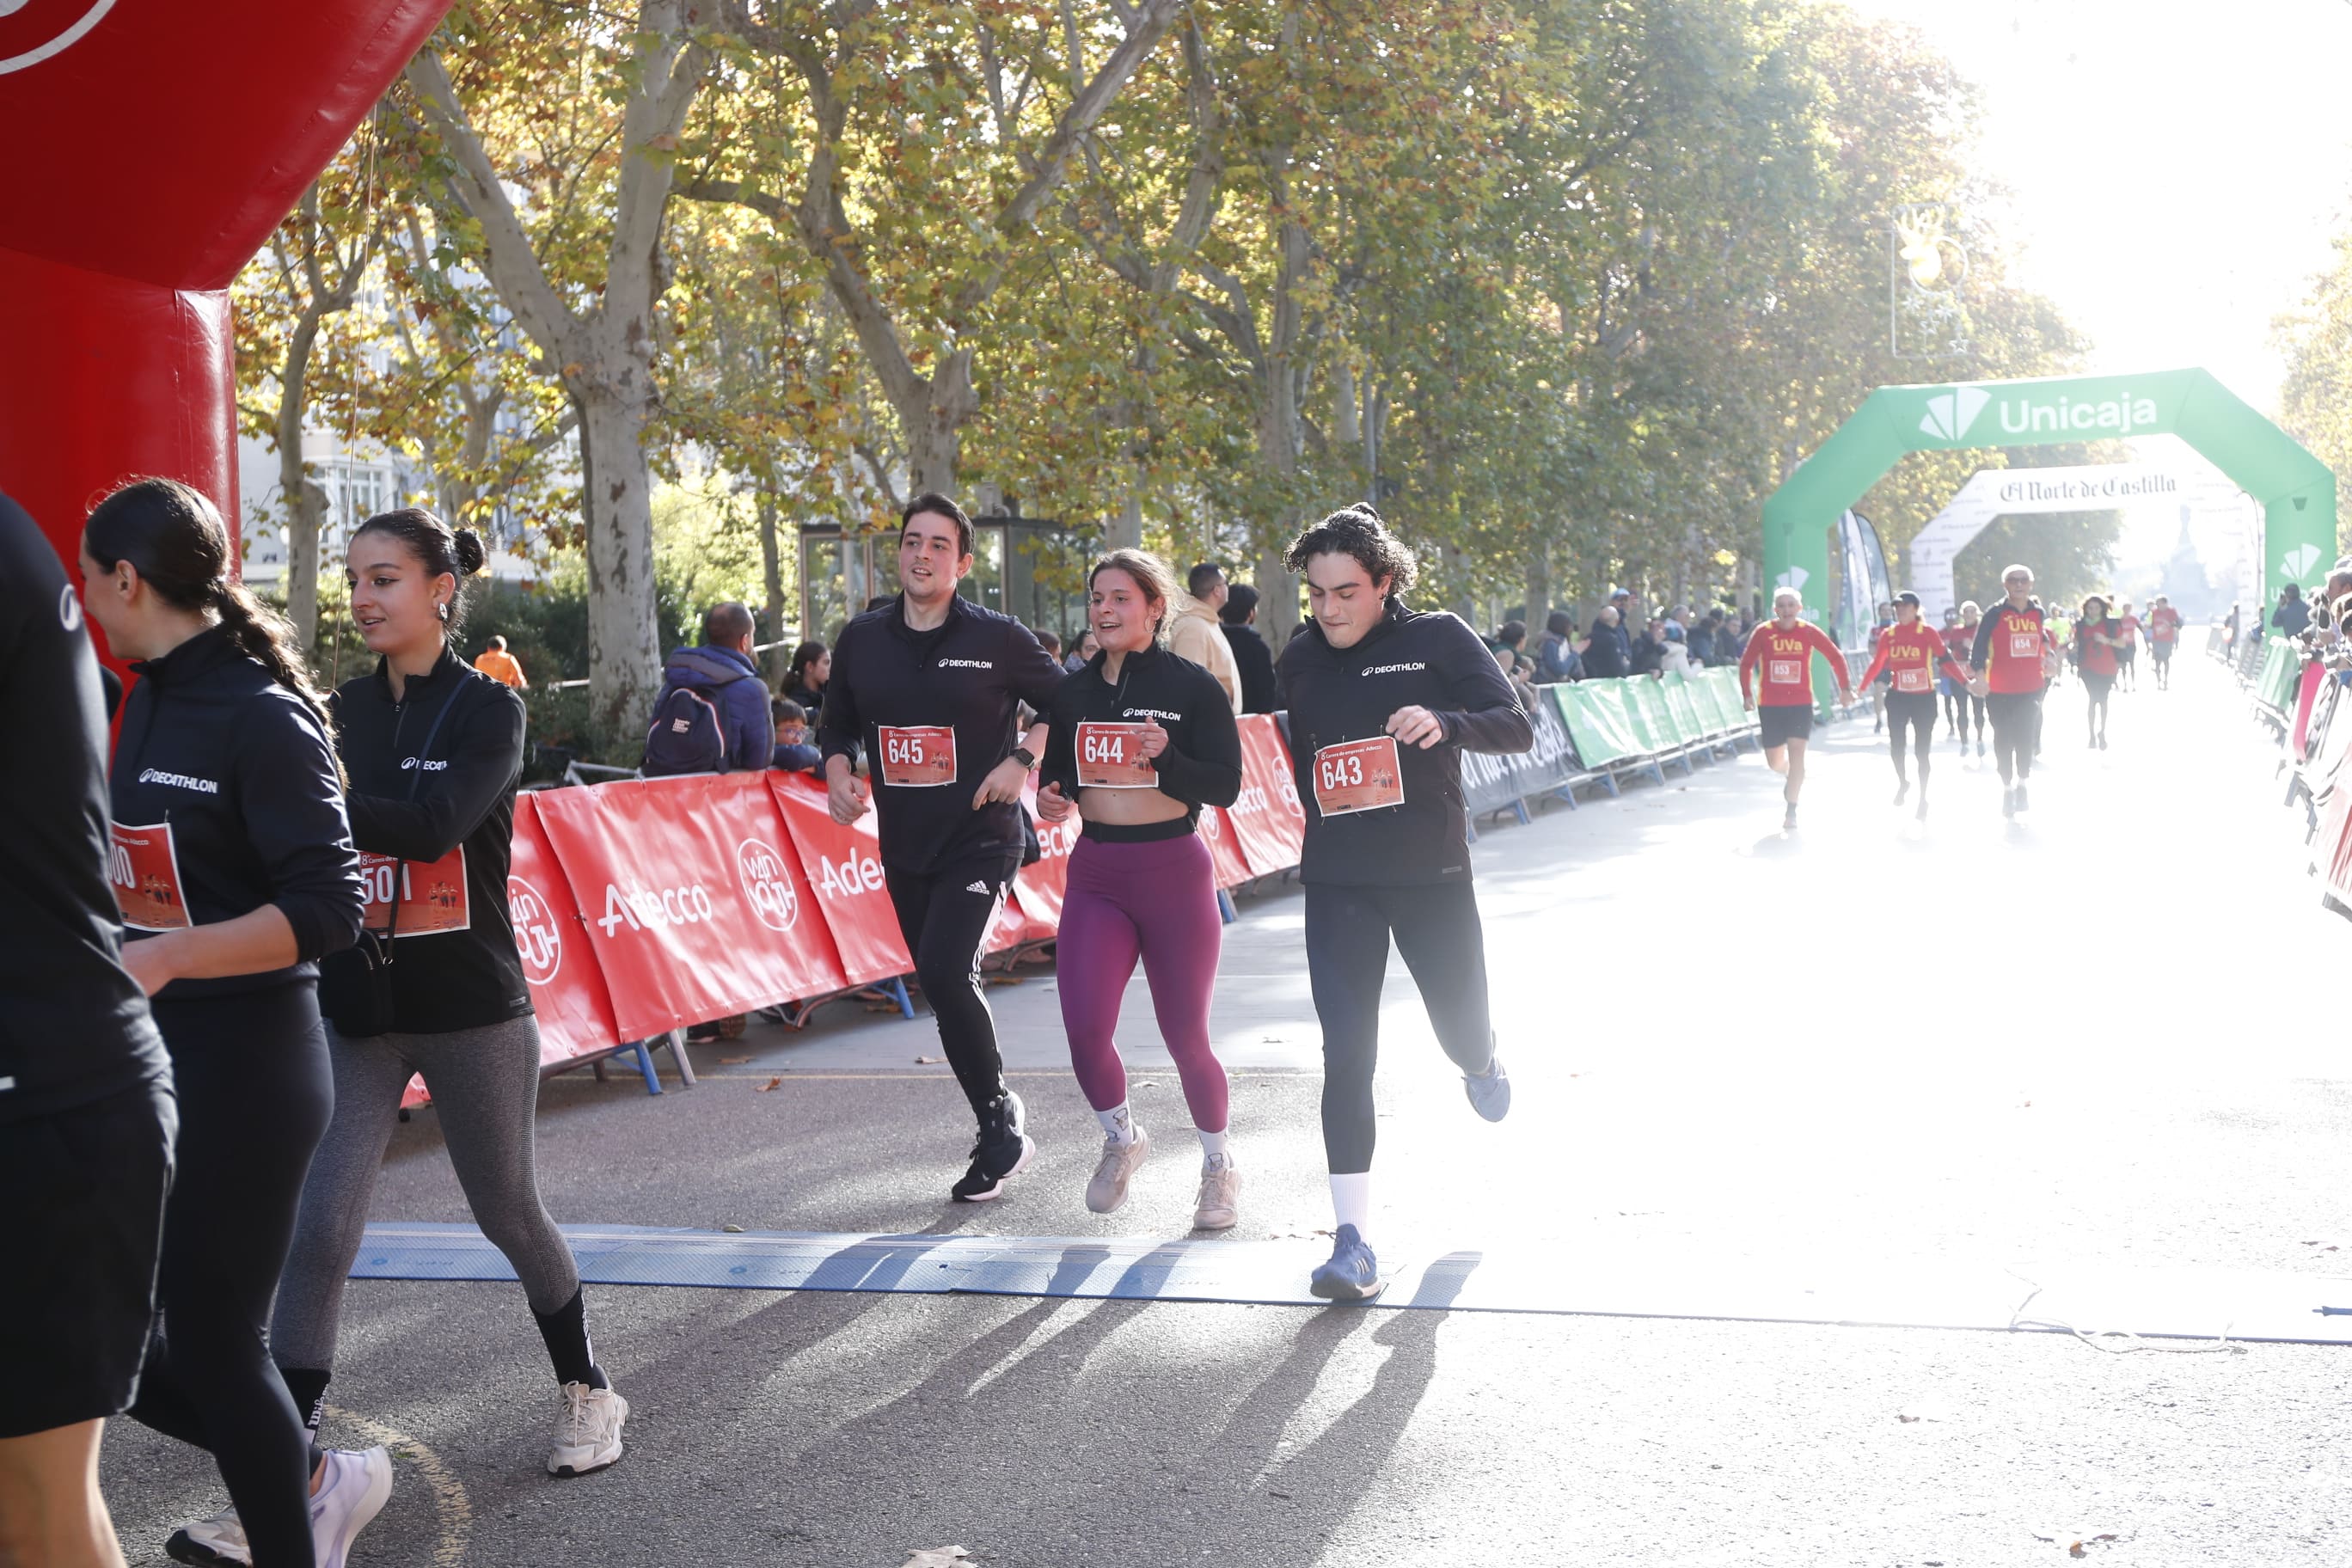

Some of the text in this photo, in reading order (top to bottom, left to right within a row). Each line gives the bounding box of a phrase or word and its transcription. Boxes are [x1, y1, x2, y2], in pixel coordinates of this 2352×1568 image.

[2000, 392, 2158, 433] Unicaja
[2000, 475, 2177, 503] El Norte de Castilla
[2009, 618, 2037, 632] UVa
[1773, 639, 1803, 652] UVa
[1890, 645, 1920, 658] UVa
[949, 659, 992, 669] DECATHLON
[1375, 662, 1425, 674] DECATHLON
[1134, 709, 1181, 721] DECATHLON
[888, 738, 923, 764] 645
[1085, 736, 1124, 763] 644
[151, 771, 218, 793] DECATHLON
[1321, 756, 1363, 790] 643
[110, 841, 136, 889] 00
[820, 847, 884, 899] Ade
[361, 863, 412, 904] 501
[965, 885, 990, 895] adidas
[597, 879, 713, 938] Adecco
